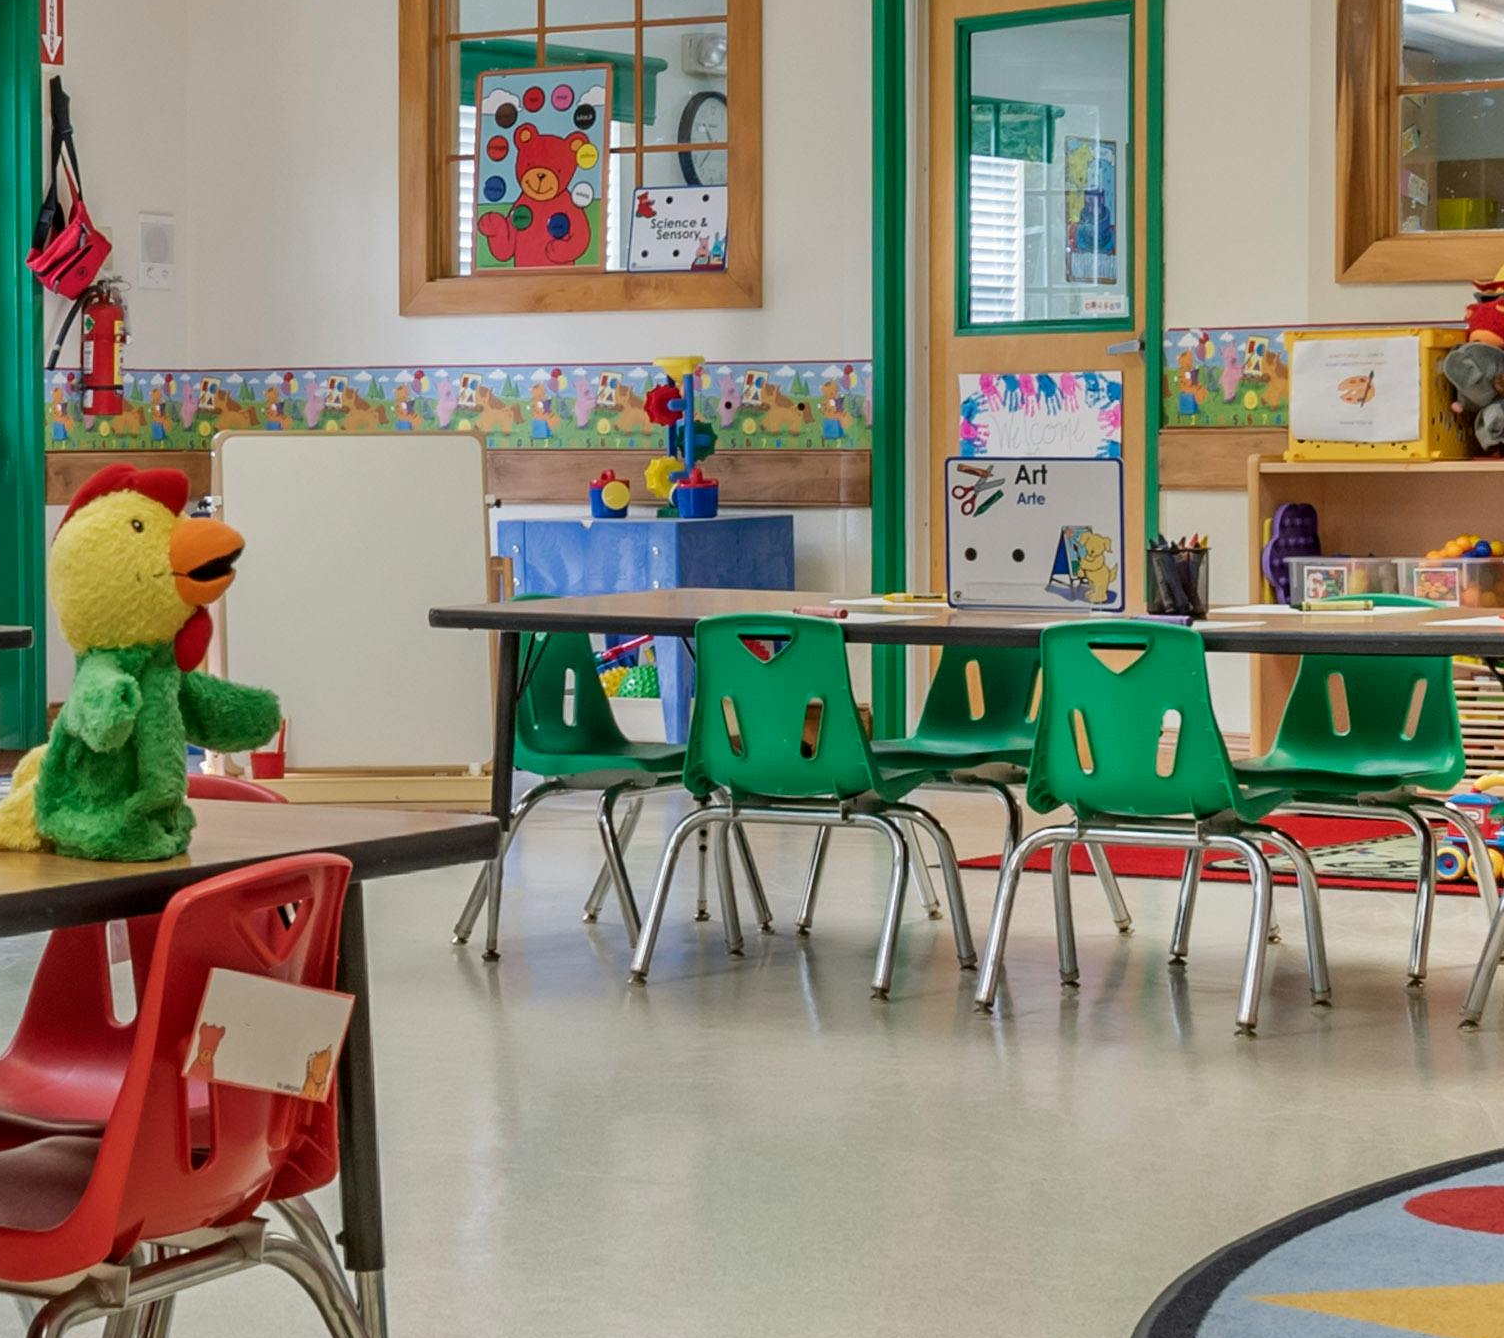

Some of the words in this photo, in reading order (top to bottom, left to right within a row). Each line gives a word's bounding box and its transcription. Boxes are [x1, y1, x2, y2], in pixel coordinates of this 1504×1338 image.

[650, 218, 697, 229] Science
[700, 217, 708, 227] &
[656, 229, 700, 241] Sensory
[995, 415, 1086, 449] Welcome
[1015, 464, 1048, 485] Art
[1017, 492, 1046, 506] Arte
